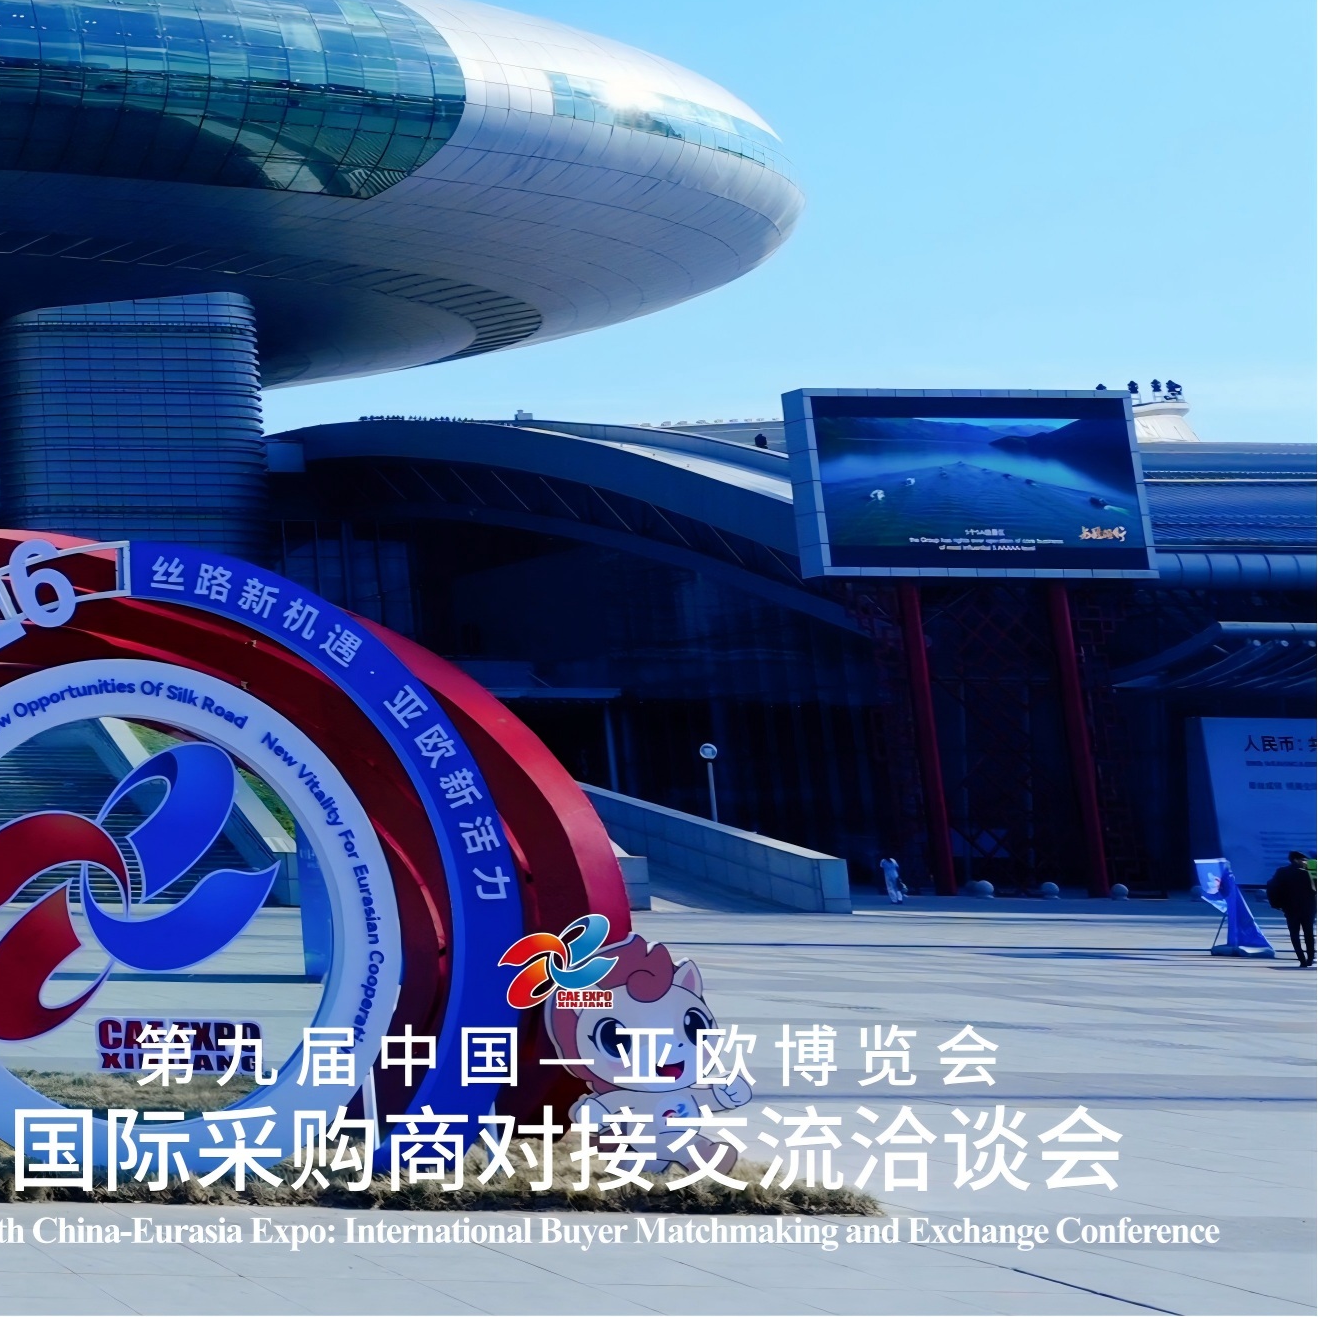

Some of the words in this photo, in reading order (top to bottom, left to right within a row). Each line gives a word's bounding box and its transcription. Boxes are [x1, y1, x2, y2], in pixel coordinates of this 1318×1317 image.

[13, 678, 136, 718] Opportunities
[140, 680, 164, 696] Of
[166, 685, 199, 707] Silk
[200, 695, 249, 730] Road
[261, 731, 298, 767] New
[298, 763, 344, 826] Vitality
[338, 829, 360, 859] For
[352, 864, 382, 945] Eurasian
